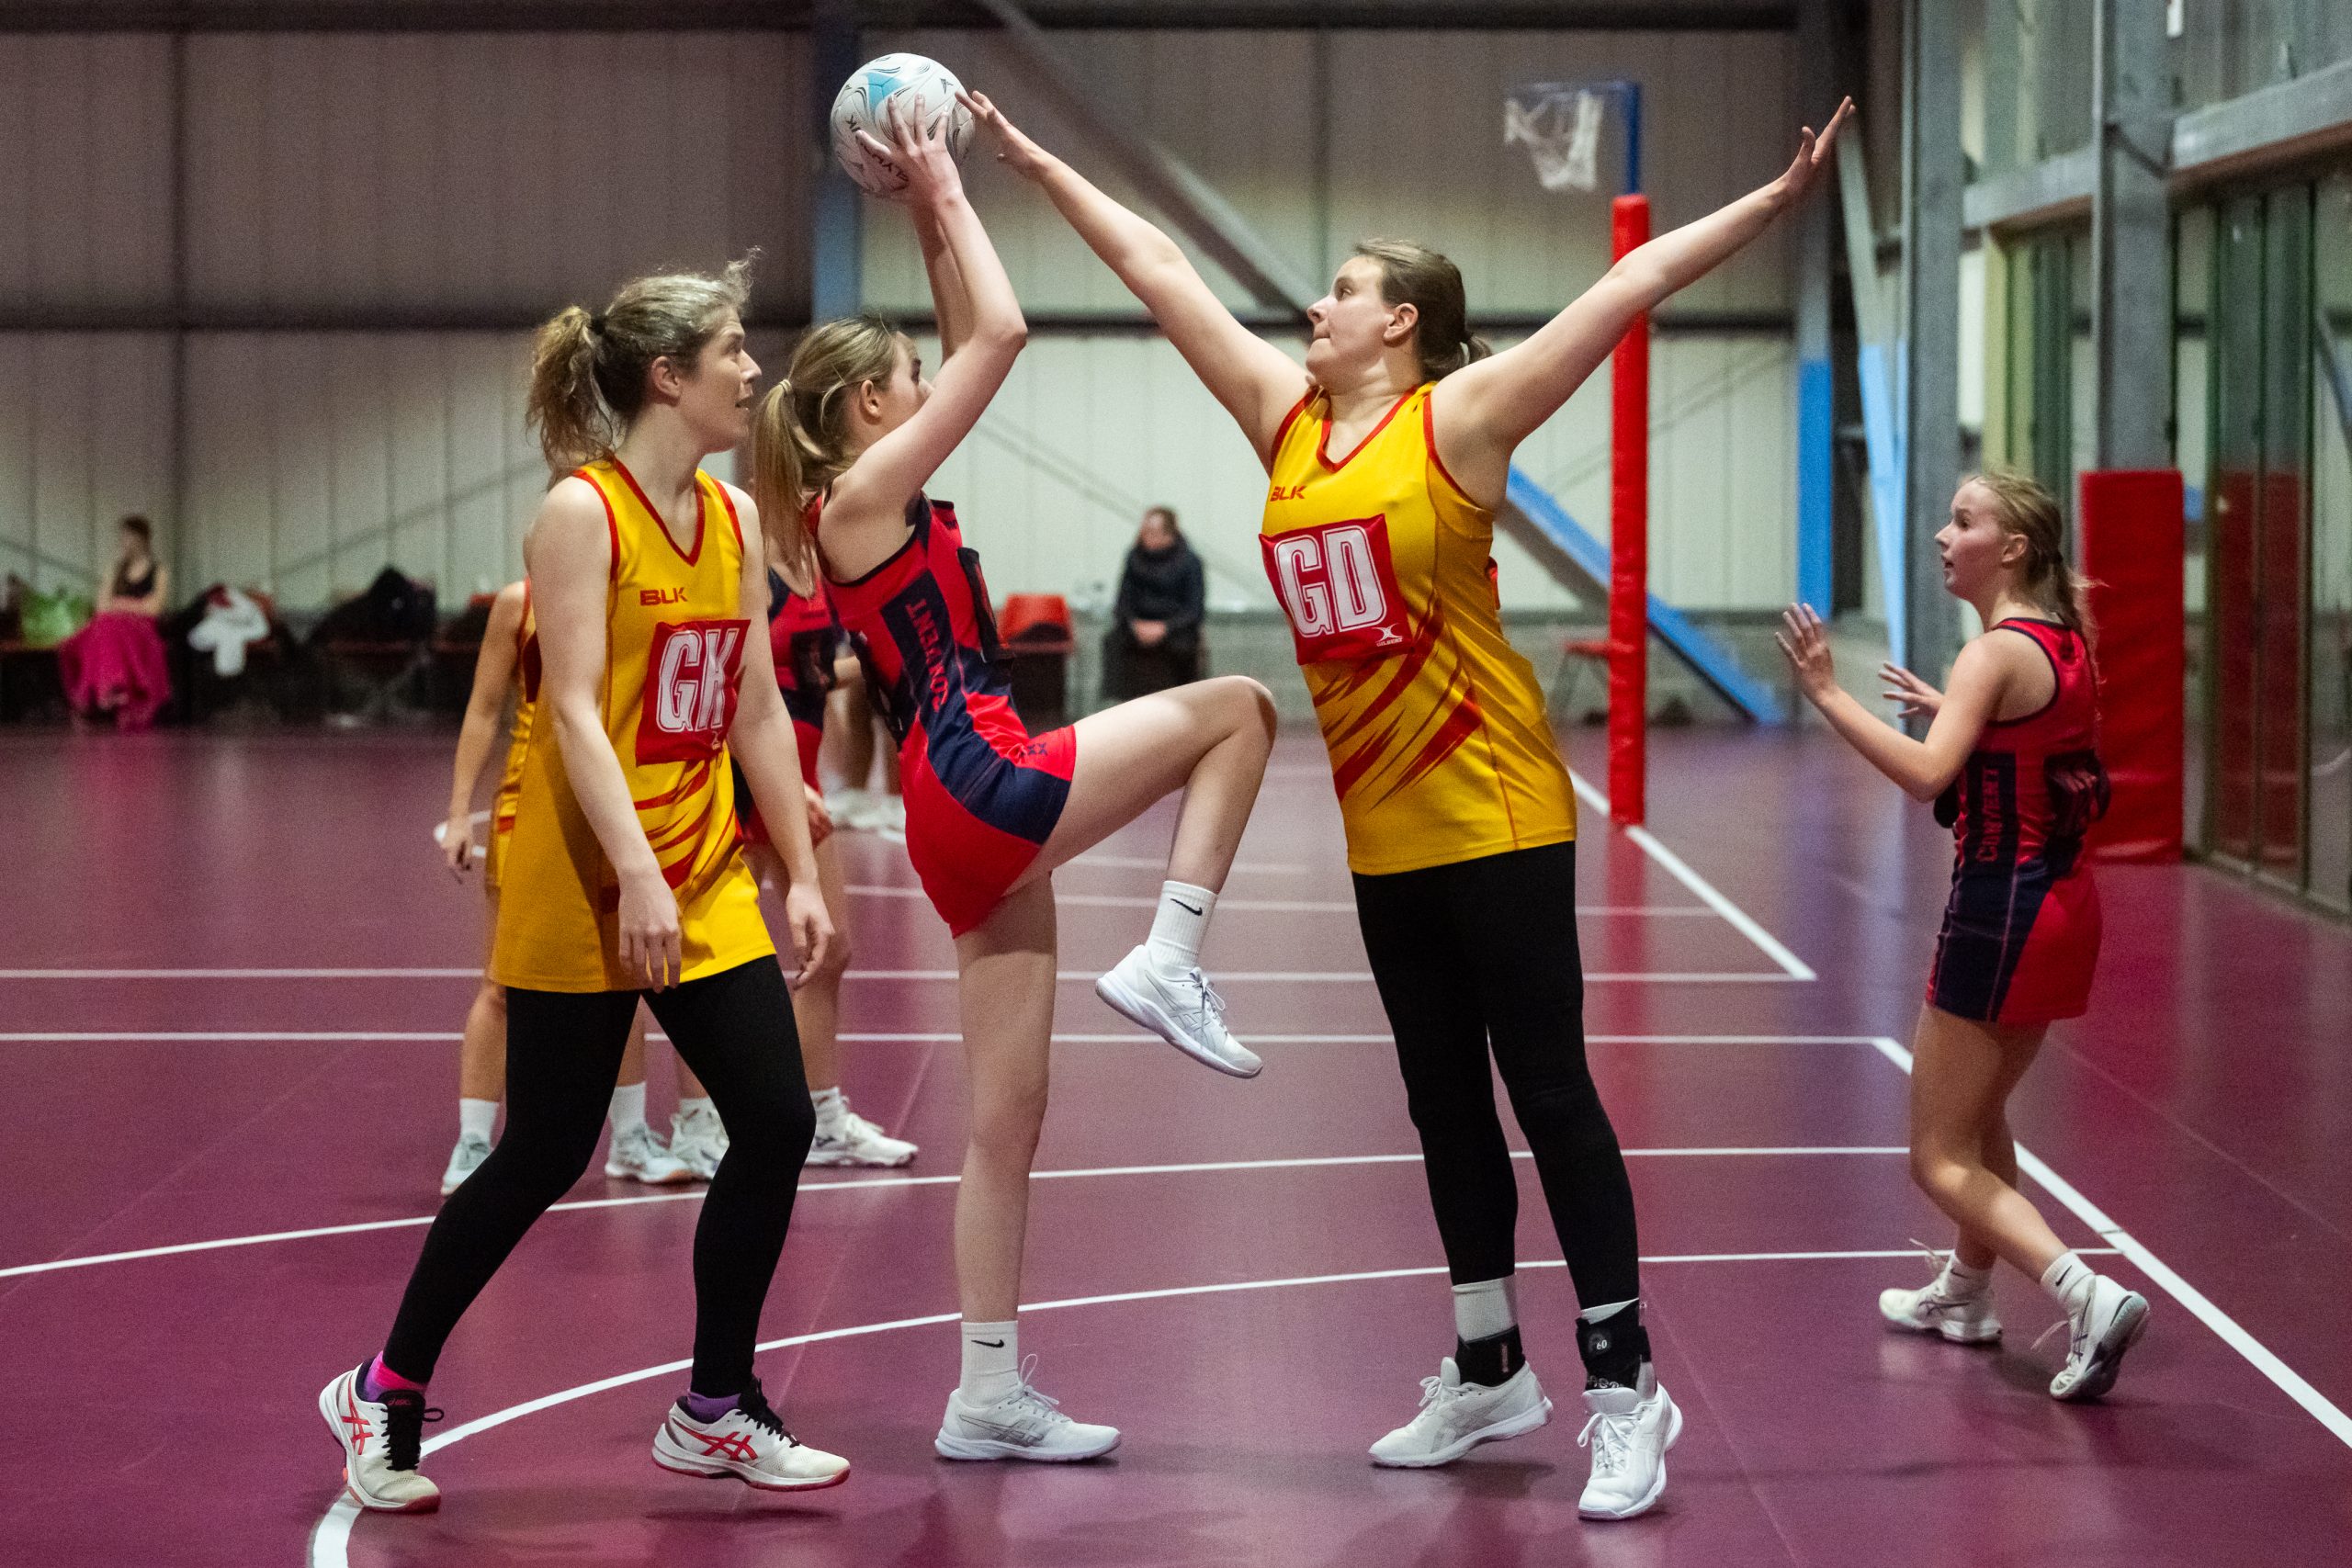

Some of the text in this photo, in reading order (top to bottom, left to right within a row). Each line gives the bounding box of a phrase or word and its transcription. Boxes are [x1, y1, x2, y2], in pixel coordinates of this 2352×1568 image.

[1270, 485, 1307, 502] BLK
[639, 587, 688, 606] BLK
[1273, 525, 1387, 638] GD
[656, 627, 740, 733] GK
